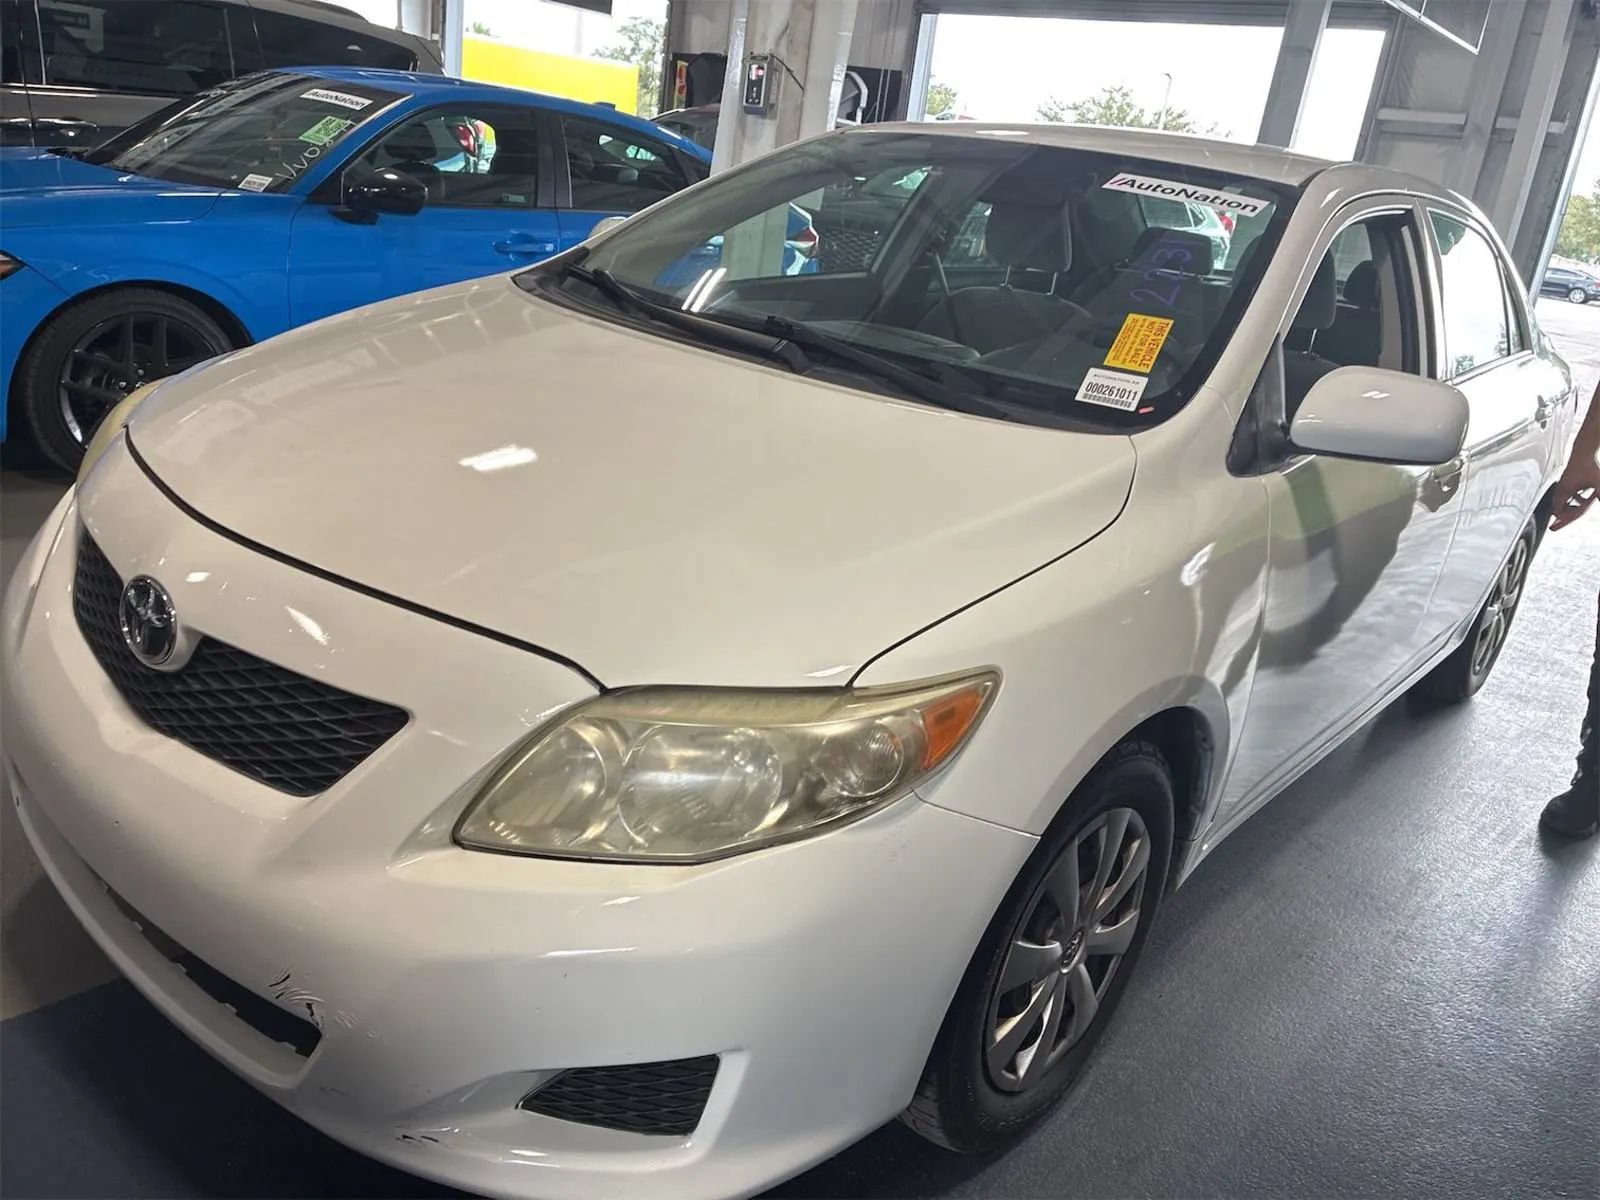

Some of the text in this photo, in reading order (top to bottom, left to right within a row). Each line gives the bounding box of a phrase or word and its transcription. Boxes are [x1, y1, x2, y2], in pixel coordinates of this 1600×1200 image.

[1120, 177, 1259, 213] AutoNation
[1143, 320, 1156, 333] NOT
[1136, 333, 1150, 347] FOR
[1137, 321, 1169, 368] THIS VEHICLE
[1128, 347, 1143, 364] SALE
[1085, 382, 1138, 401] 000261011
